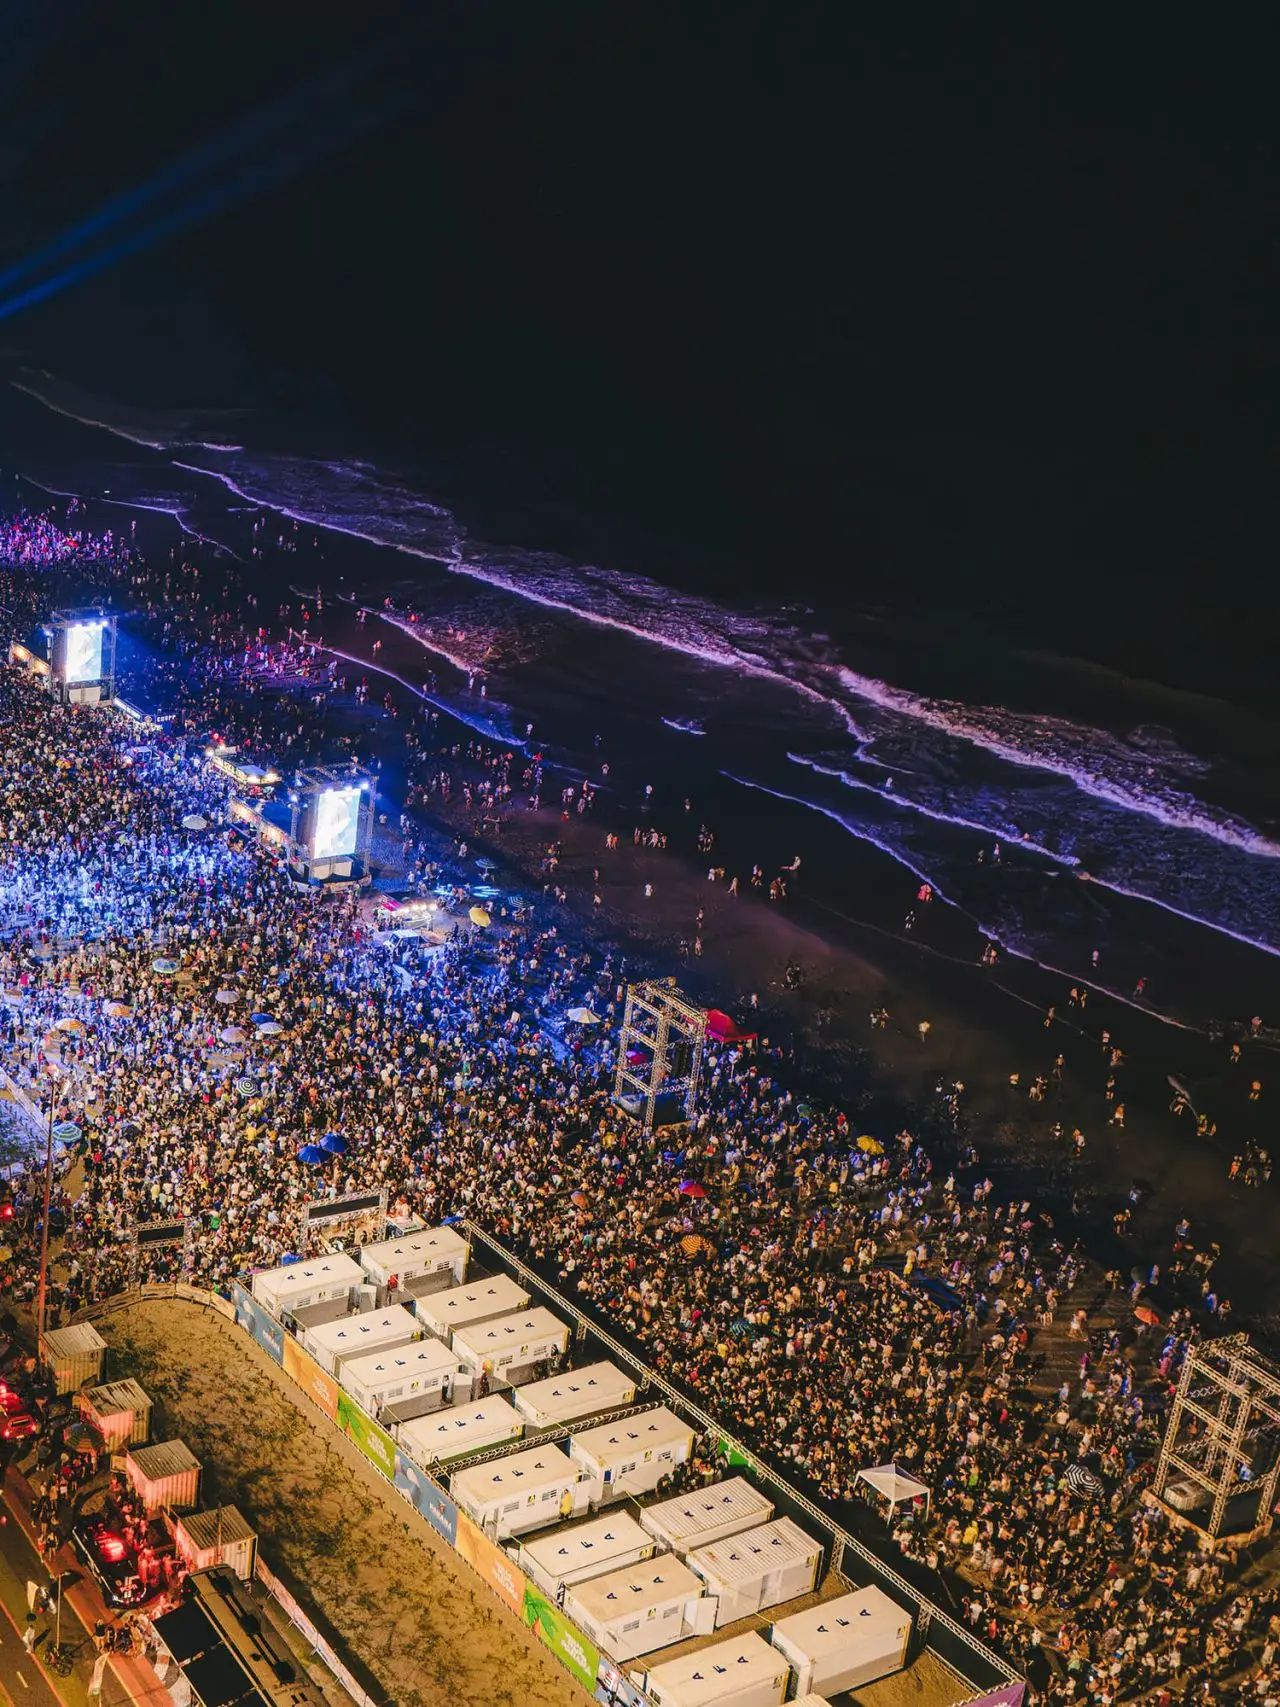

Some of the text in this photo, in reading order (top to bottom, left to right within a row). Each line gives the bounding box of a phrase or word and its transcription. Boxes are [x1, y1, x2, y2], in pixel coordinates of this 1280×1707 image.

[394, 1240, 438, 1254] AFA
[287, 1265, 331, 1280] AFA
[447, 1289, 497, 1306] AFA
[337, 1320, 392, 1337] AFA
[487, 1322, 535, 1337] AFA
[375, 1353, 427, 1371] AFA
[552, 1379, 598, 1396] AFA
[437, 1414, 485, 1432] AFA
[608, 1425, 659, 1444] AFA
[492, 1462, 545, 1482] AFA
[683, 1496, 733, 1518] AFA
[558, 1533, 615, 1555] AFA
[729, 1539, 782, 1561] AFA
[606, 1576, 664, 1600] AFA
[816, 1608, 872, 1633] AFA
[692, 1656, 749, 1680] AFA
